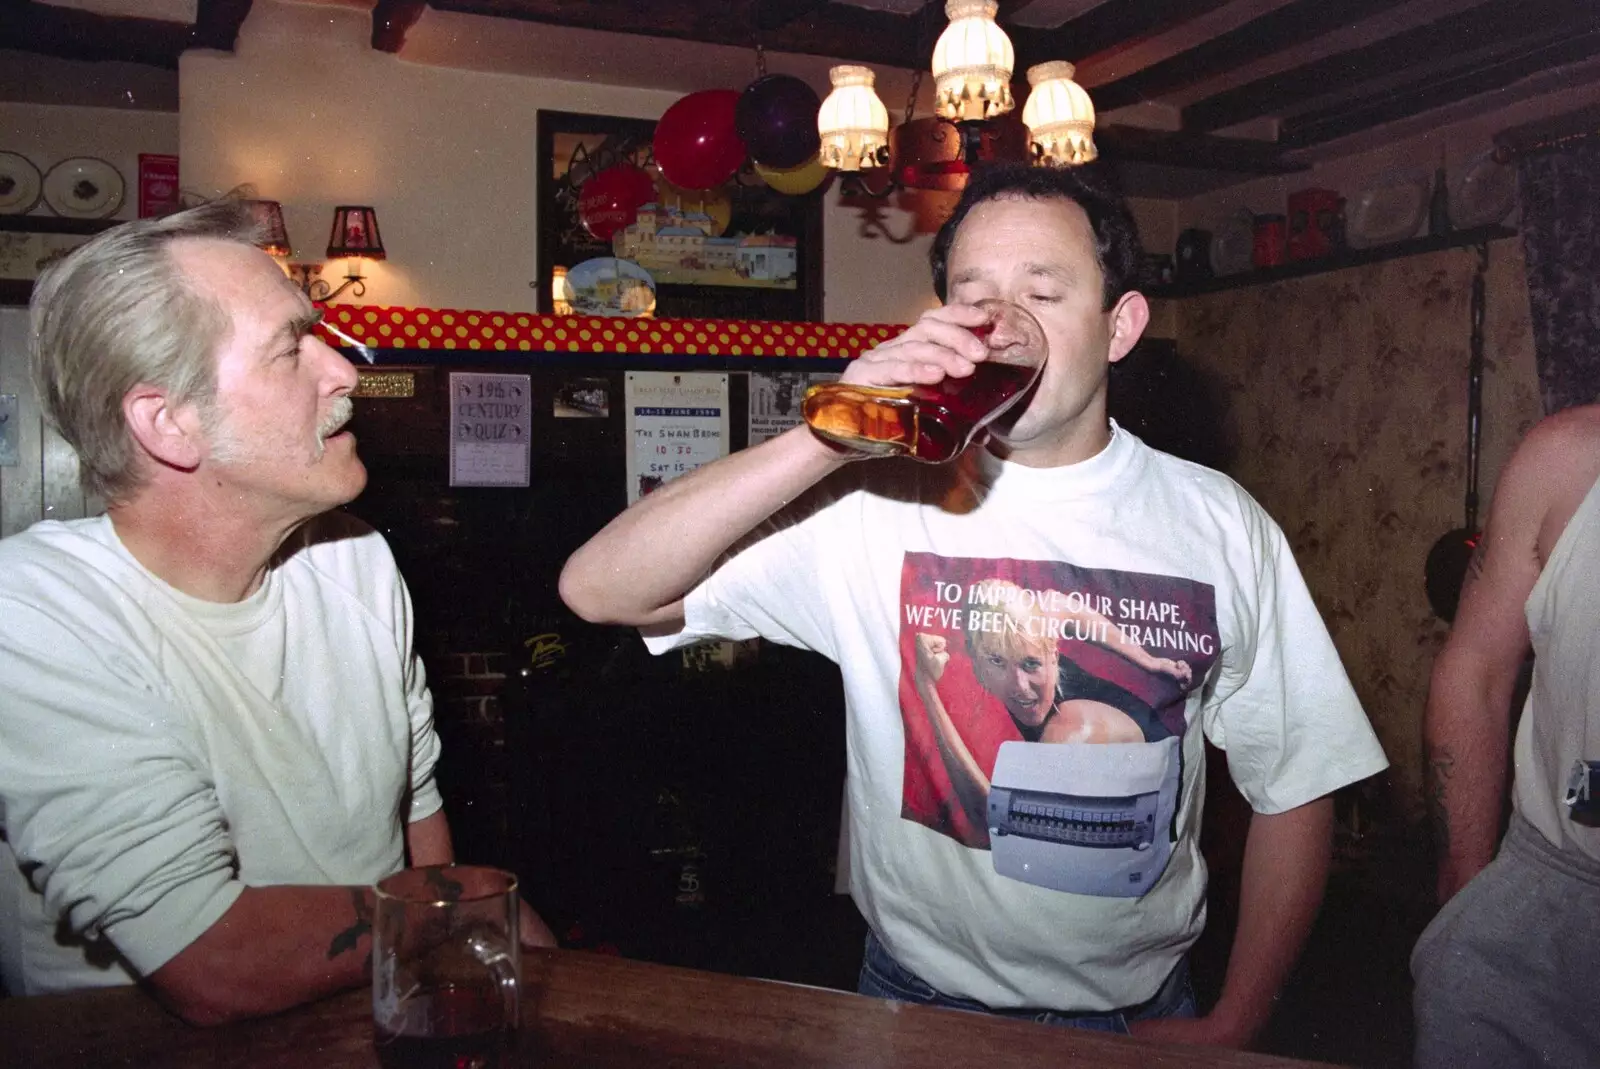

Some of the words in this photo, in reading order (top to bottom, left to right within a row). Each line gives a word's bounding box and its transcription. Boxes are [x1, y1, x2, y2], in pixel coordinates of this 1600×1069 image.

[477, 381, 505, 398] 19th
[458, 402, 522, 419] CENTURY
[475, 423, 508, 441] QUIZ
[659, 429, 690, 438] SWAN
[650, 463, 669, 472] SAT
[934, 580, 962, 604] TO
[968, 583, 1061, 612] IMPROVE
[1067, 591, 1113, 616] OUR
[1119, 598, 1187, 630] SHAPE,
[905, 604, 962, 630] WE'VE
[968, 609, 1020, 635] BEEN
[1025, 616, 1109, 643] CIRCUIT
[1116, 623, 1214, 656] TRAINING
